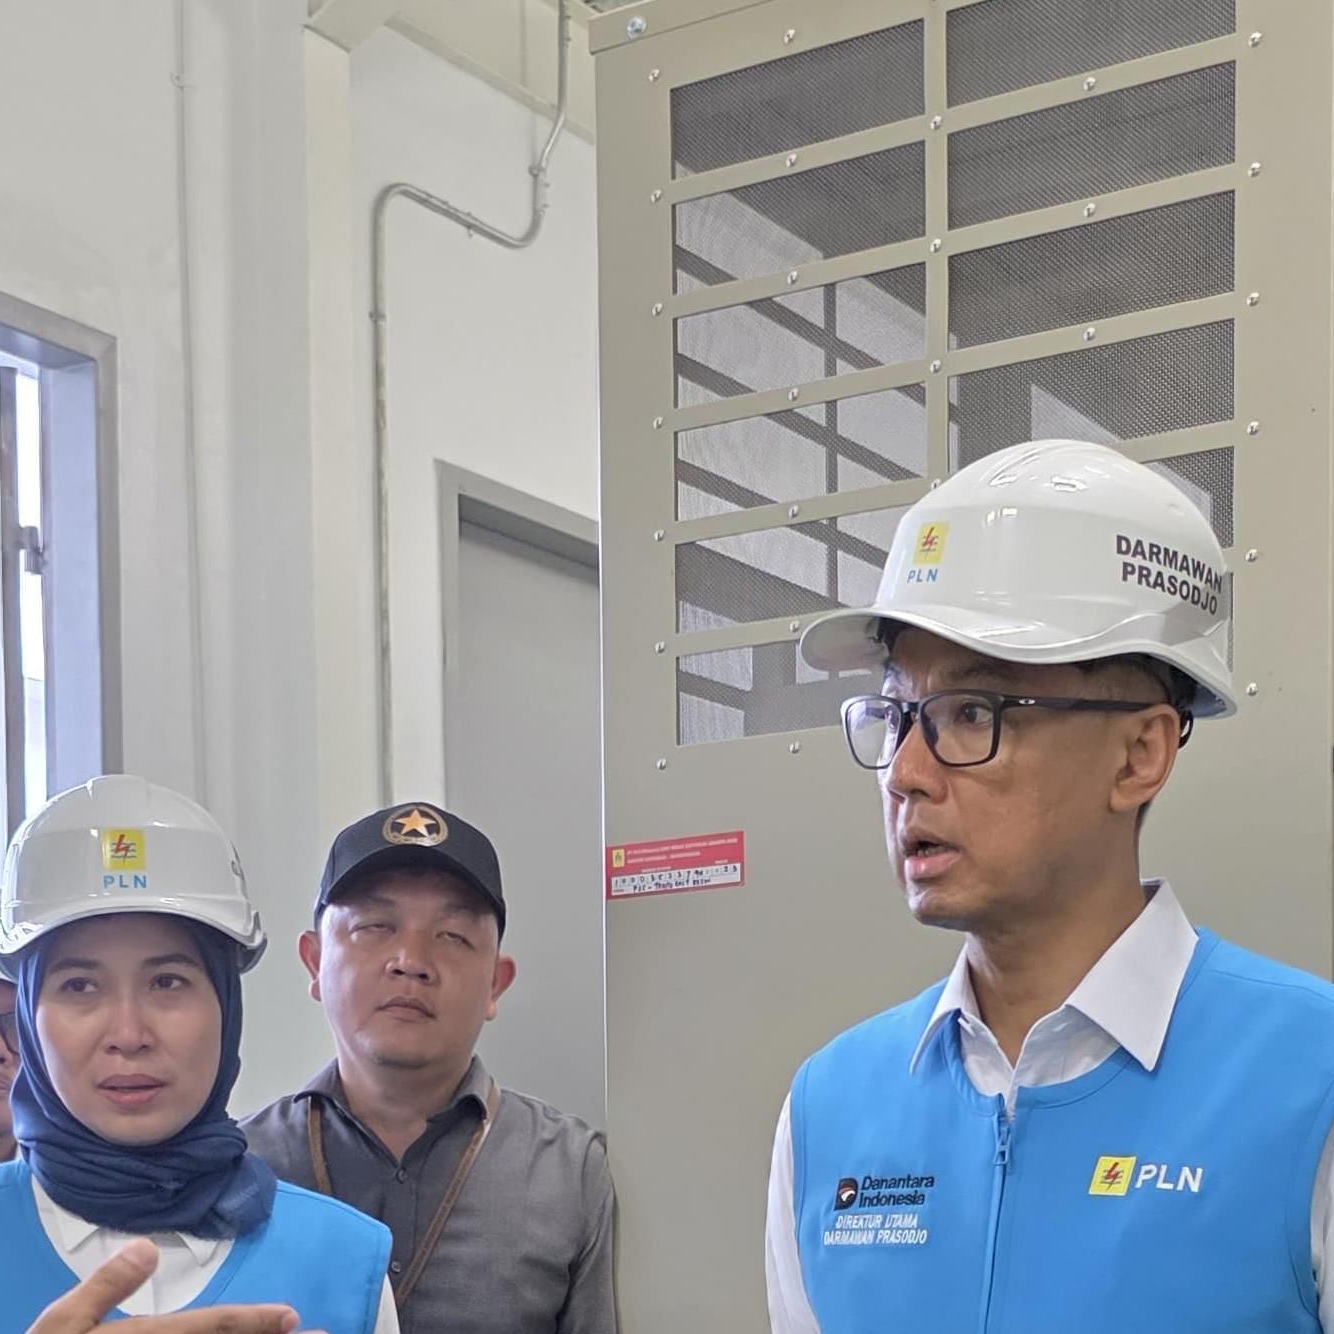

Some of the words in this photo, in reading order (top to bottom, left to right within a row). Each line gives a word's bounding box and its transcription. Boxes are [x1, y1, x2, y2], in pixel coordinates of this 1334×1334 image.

[1116, 534, 1223, 594] DARMAWAN
[906, 568, 938, 584] PLN
[1122, 561, 1218, 616] PRASODJO
[102, 874, 147, 889] PLN
[861, 1173, 935, 1191] Danantara
[1134, 1163, 1204, 1193] PLN
[858, 1190, 925, 1208] Indonesia
[835, 1214, 883, 1230] DIREKTUR
[884, 1213, 918, 1229] UTAMA
[823, 1230, 875, 1245] DARMAWAN
[875, 1229, 928, 1245] PRASODJO
